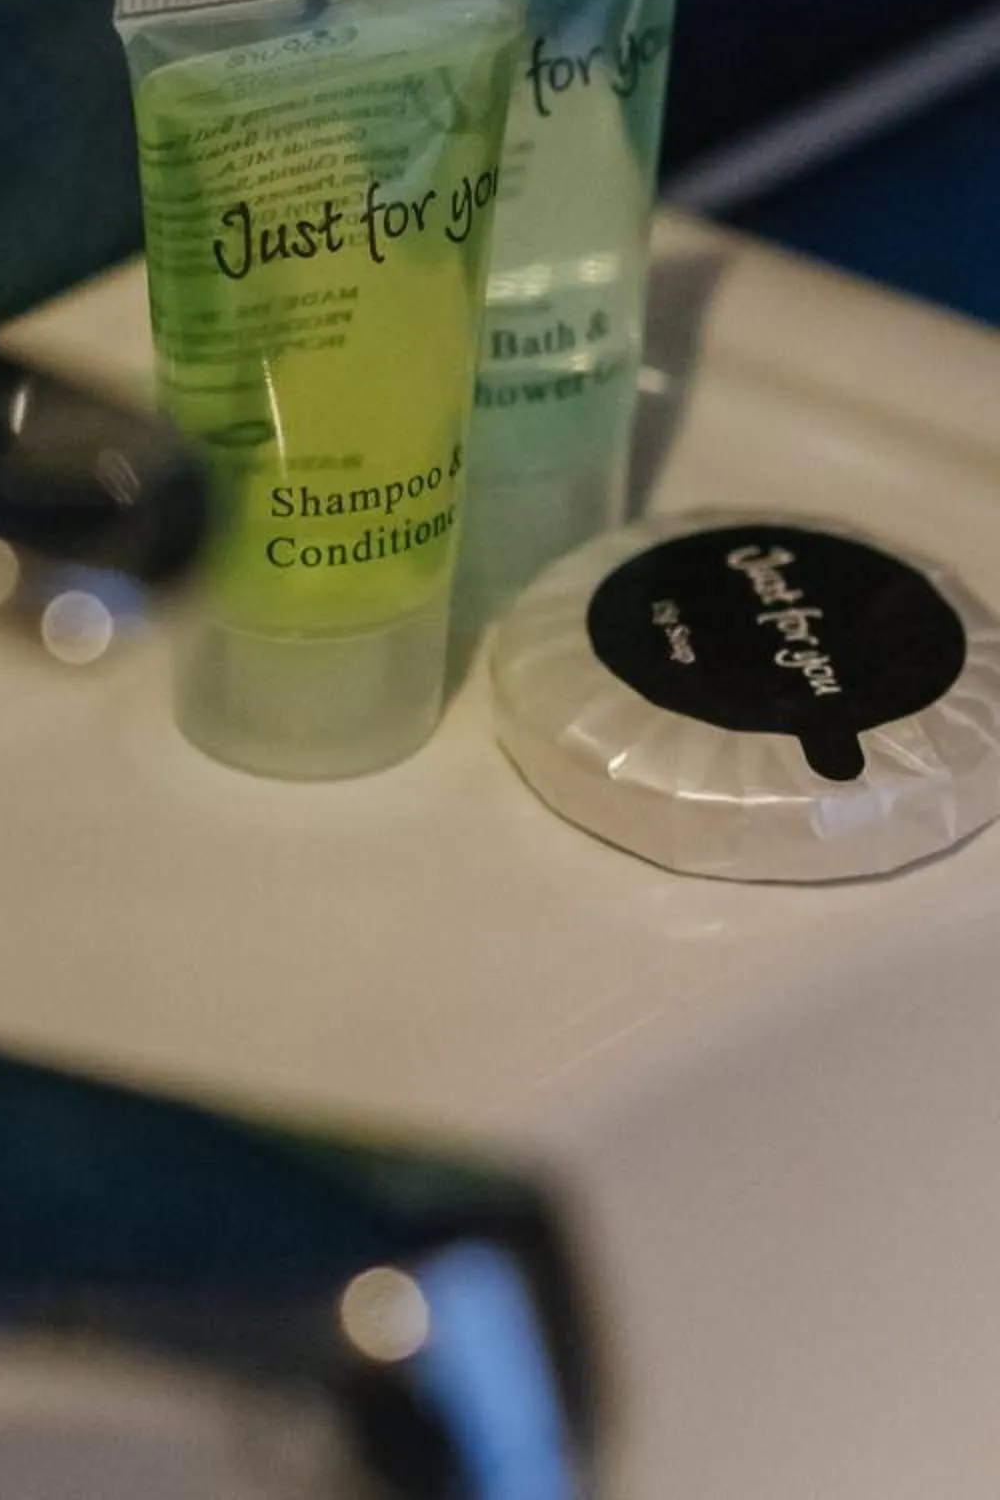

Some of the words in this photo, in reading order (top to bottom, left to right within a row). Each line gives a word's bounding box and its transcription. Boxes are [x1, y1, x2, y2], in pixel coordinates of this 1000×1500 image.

[526, 36, 602, 117] for
[609, 25, 668, 99] yo
[213, 202, 343, 279] Just
[359, 182, 434, 263] for
[491, 319, 577, 360] Bath
[473, 370, 586, 408] hower
[271, 463, 443, 521] Shampoo
[266, 503, 457, 569] Condition
[727, 545, 806, 605] Just
[756, 606, 824, 647] for
[774, 646, 841, 697] you
